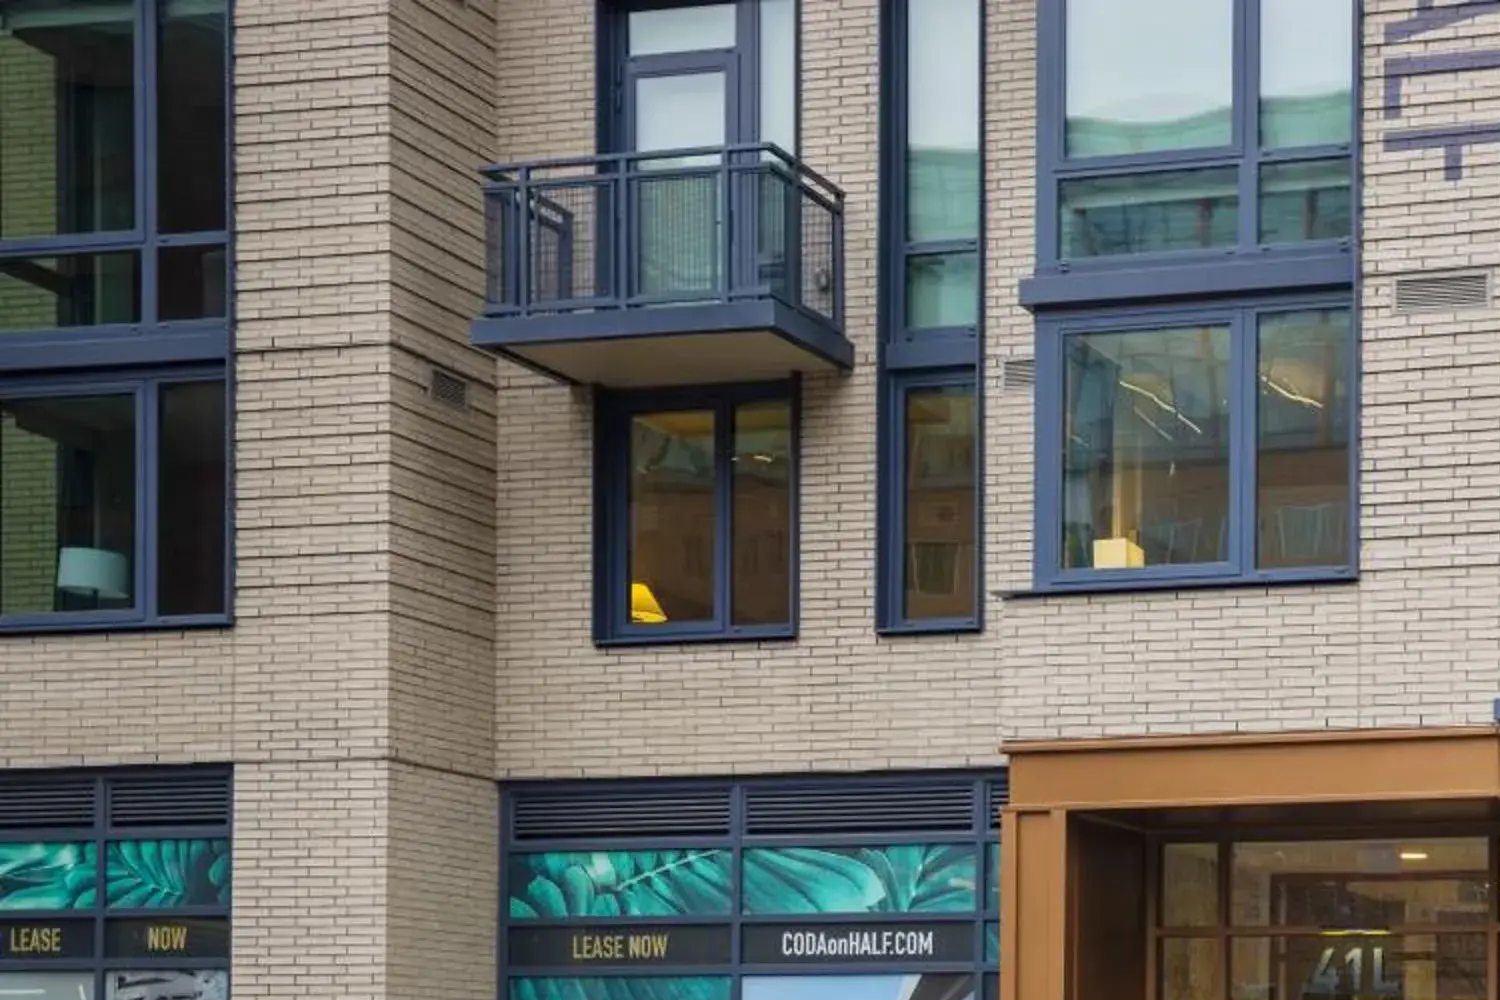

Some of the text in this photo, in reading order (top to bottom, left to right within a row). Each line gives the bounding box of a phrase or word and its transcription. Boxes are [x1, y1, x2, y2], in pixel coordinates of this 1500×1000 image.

[10, 927, 187, 952] LEASE NOW
[572, 933, 668, 960] LEASE NOW
[781, 930, 934, 957] CODAonHALF.COM
